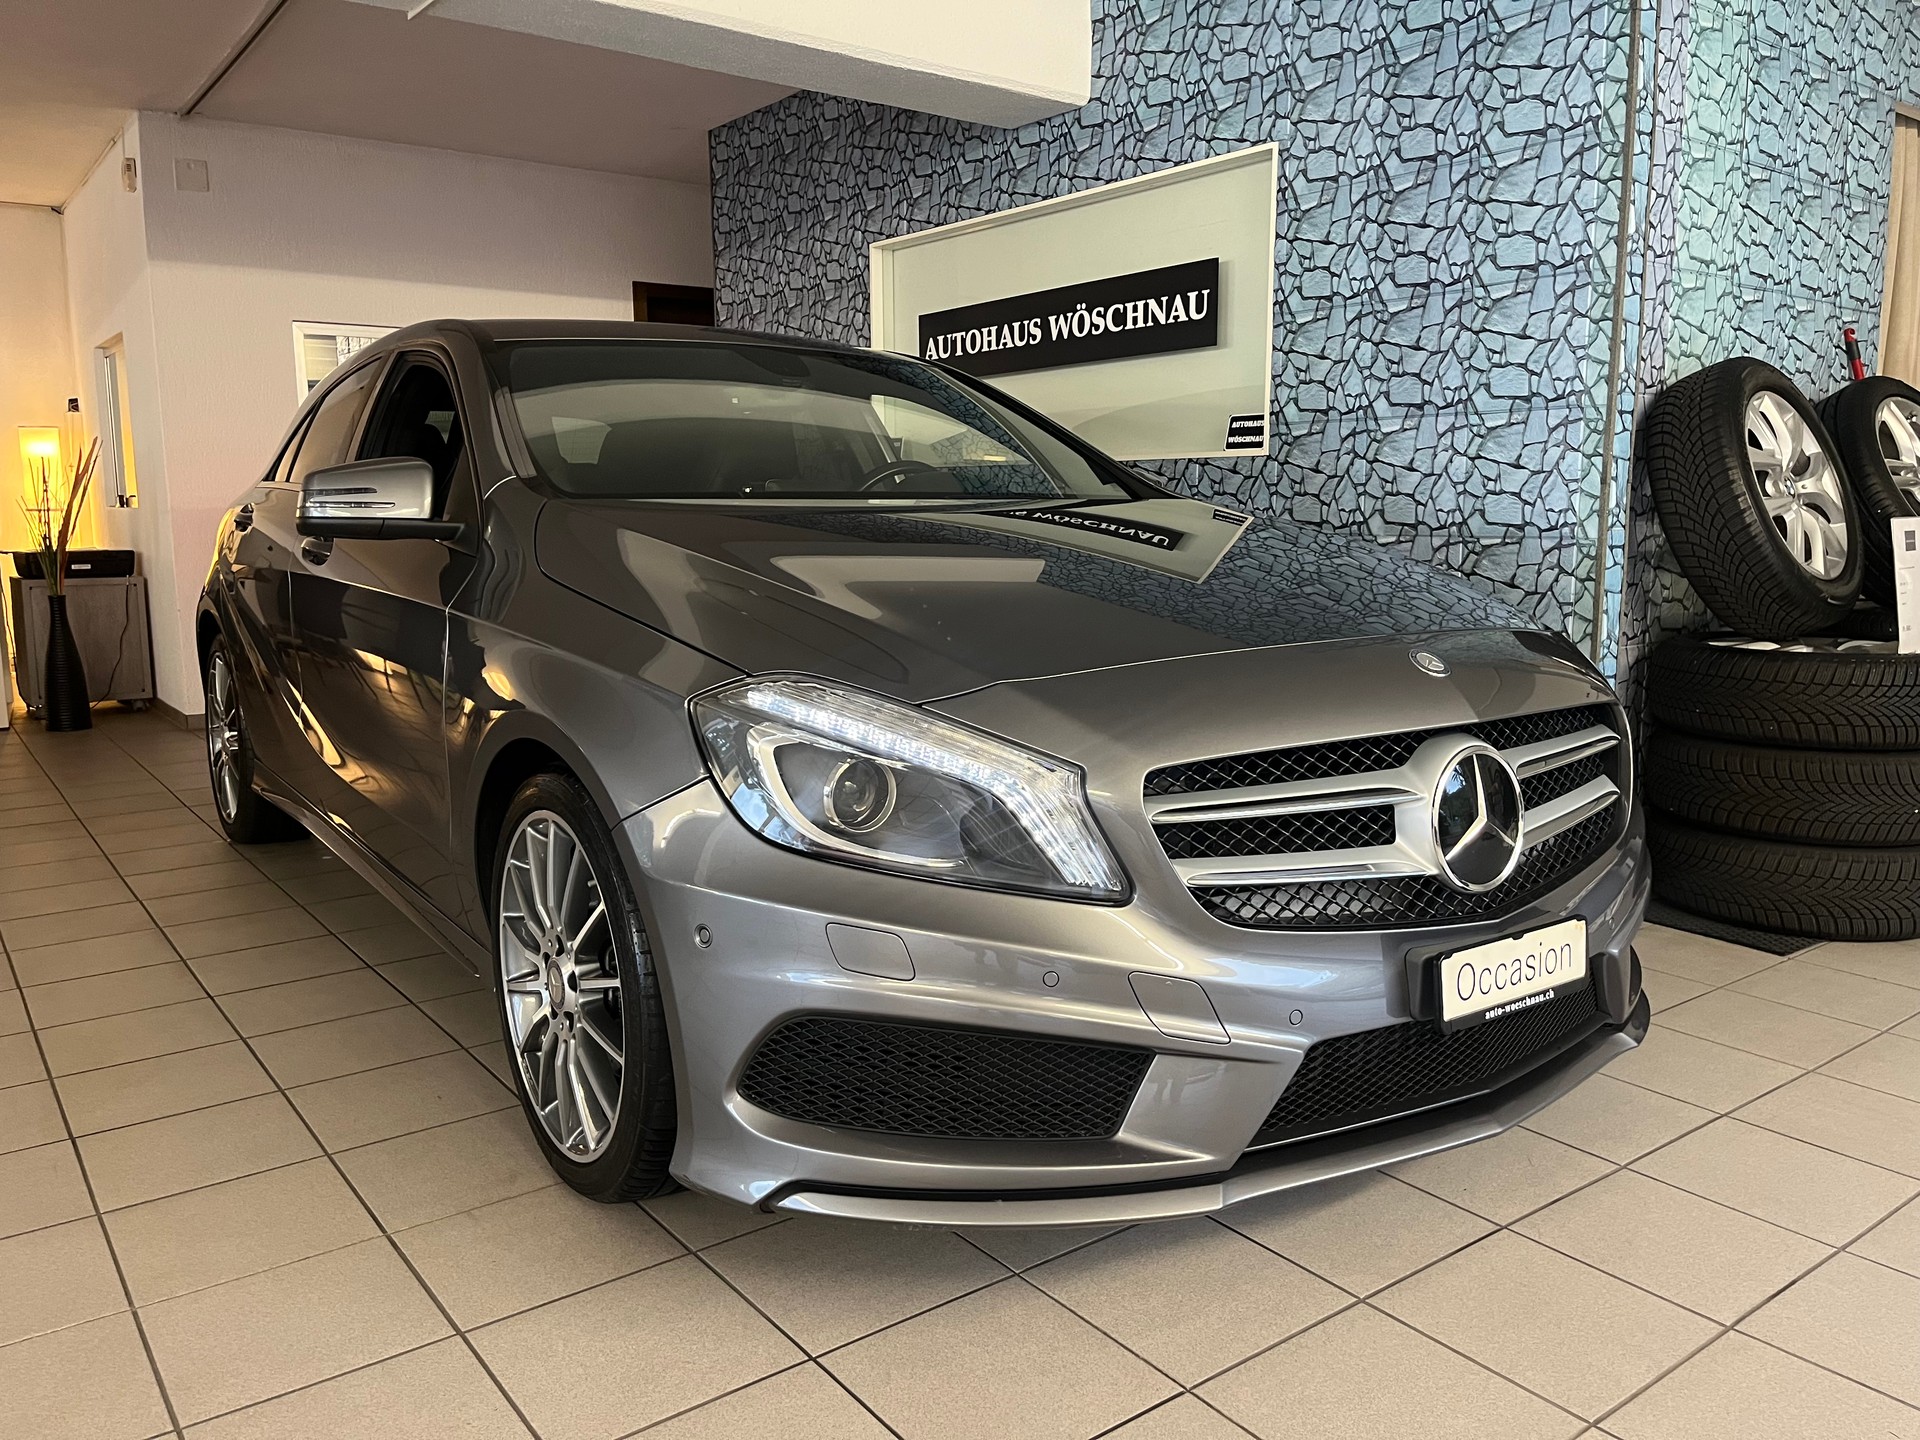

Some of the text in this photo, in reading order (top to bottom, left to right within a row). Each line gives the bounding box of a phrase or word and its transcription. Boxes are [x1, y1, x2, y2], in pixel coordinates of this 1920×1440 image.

[925, 288, 1211, 361] AUTOHAUS WÖSCHNAU
[1228, 435, 1265, 443] WÖSCHNAU
[1231, 420, 1265, 428] AUTOHAUS
[1457, 942, 1572, 1001] Occasion
[1485, 988, 1555, 1020] auto-woeschnau.ch
